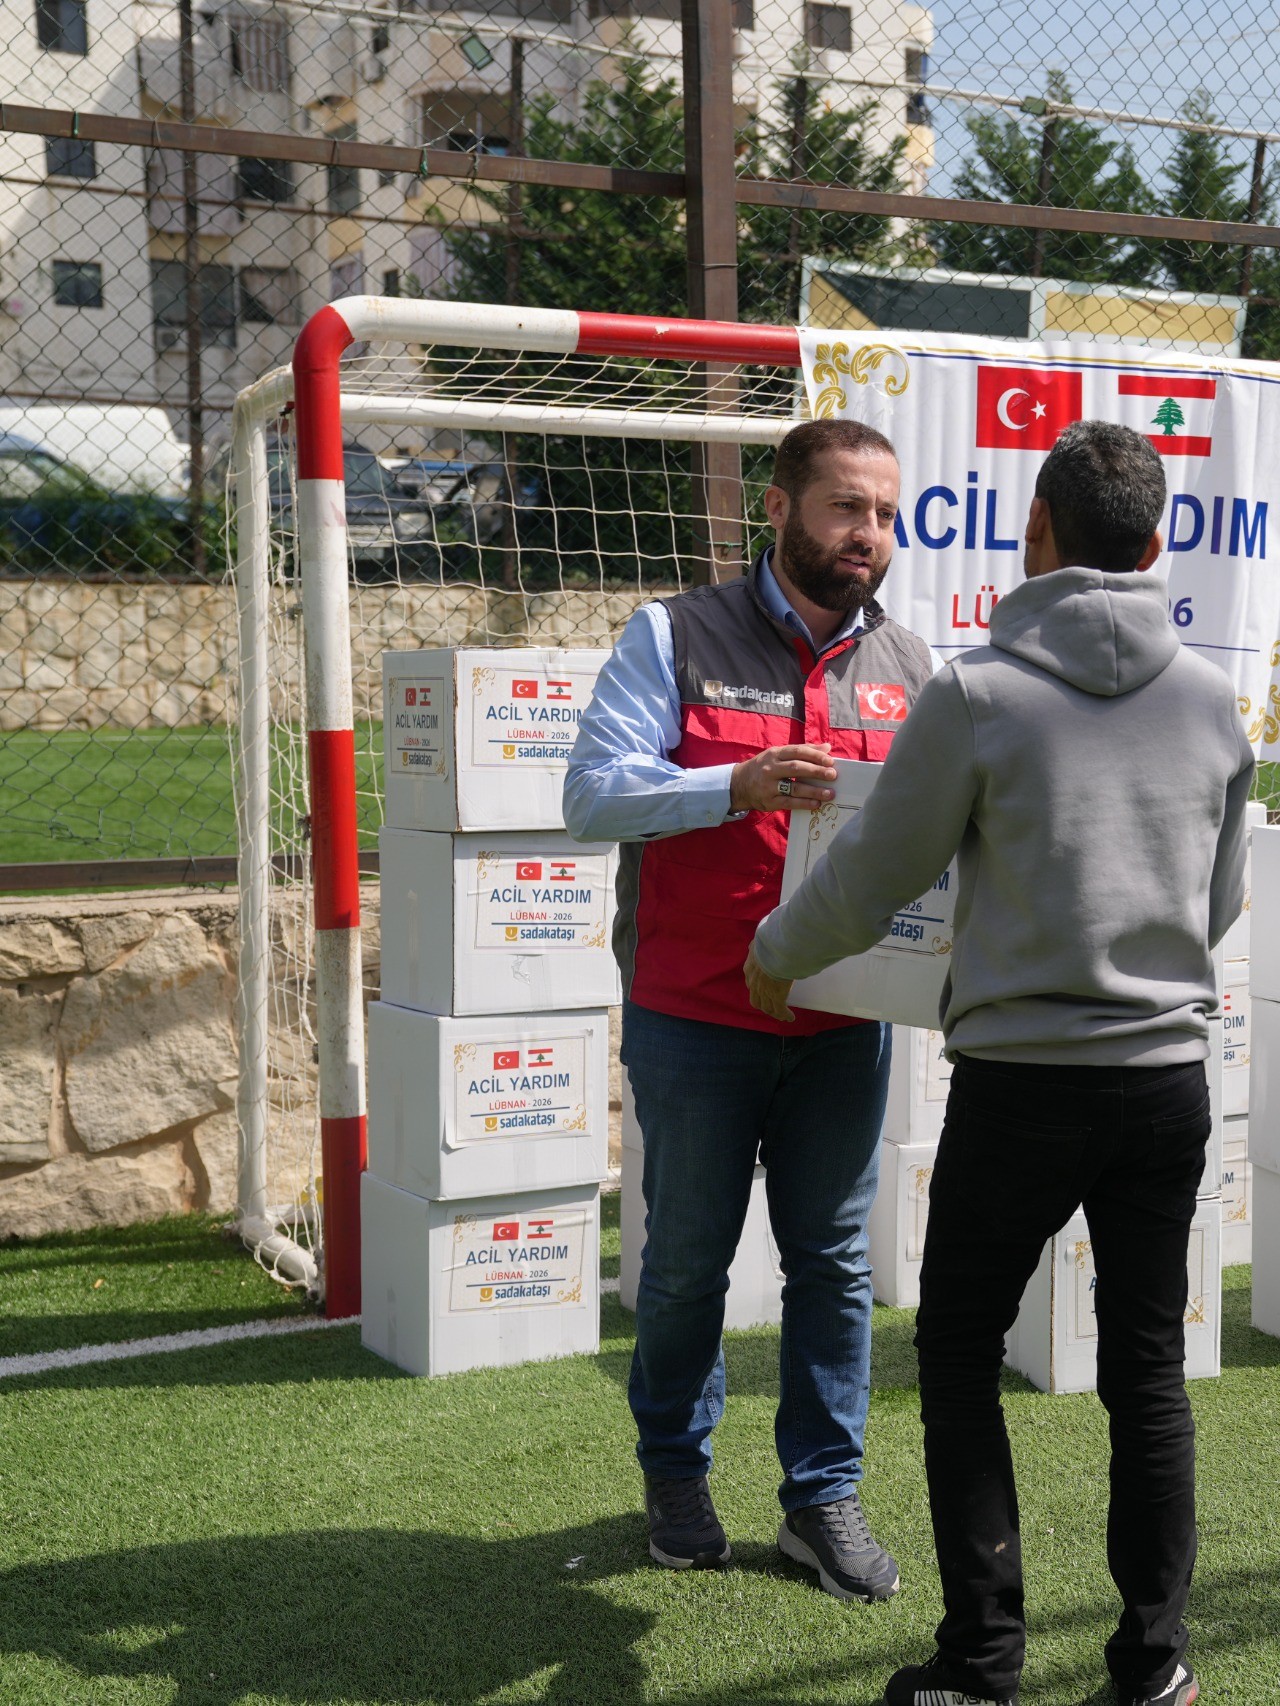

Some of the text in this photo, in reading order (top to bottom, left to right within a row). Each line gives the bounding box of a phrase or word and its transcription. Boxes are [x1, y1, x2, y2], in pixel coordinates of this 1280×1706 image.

[1166, 494, 1269, 560] DIM
[723, 685, 795, 708] sadakataşı
[486, 703, 523, 721] ACİL
[396, 711, 438, 729] ACİL YARDIM
[507, 728, 545, 739] LÜBNAN
[551, 732, 570, 740] 2026
[403, 737, 420, 746] LÜBNAN
[421, 738, 431, 747] 2026
[518, 745, 571, 760] sadakataş
[490, 885, 591, 904] ACİL YARDIM
[510, 910, 547, 921] LÜBNAN
[553, 913, 572, 921] 2026
[520, 927, 575, 941] sadakataşı
[468, 1073, 570, 1095] ACİL YARDIM
[489, 1099, 526, 1111] LÜBNAN
[532, 1098, 552, 1107] 2026
[500, 1113, 556, 1129] sadakataşı
[466, 1245, 568, 1265] ACİL YARDIM
[485, 1270, 523, 1281] LÜBNAN
[529, 1270, 548, 1278] 2026
[494, 1284, 550, 1299] sadakataşı
